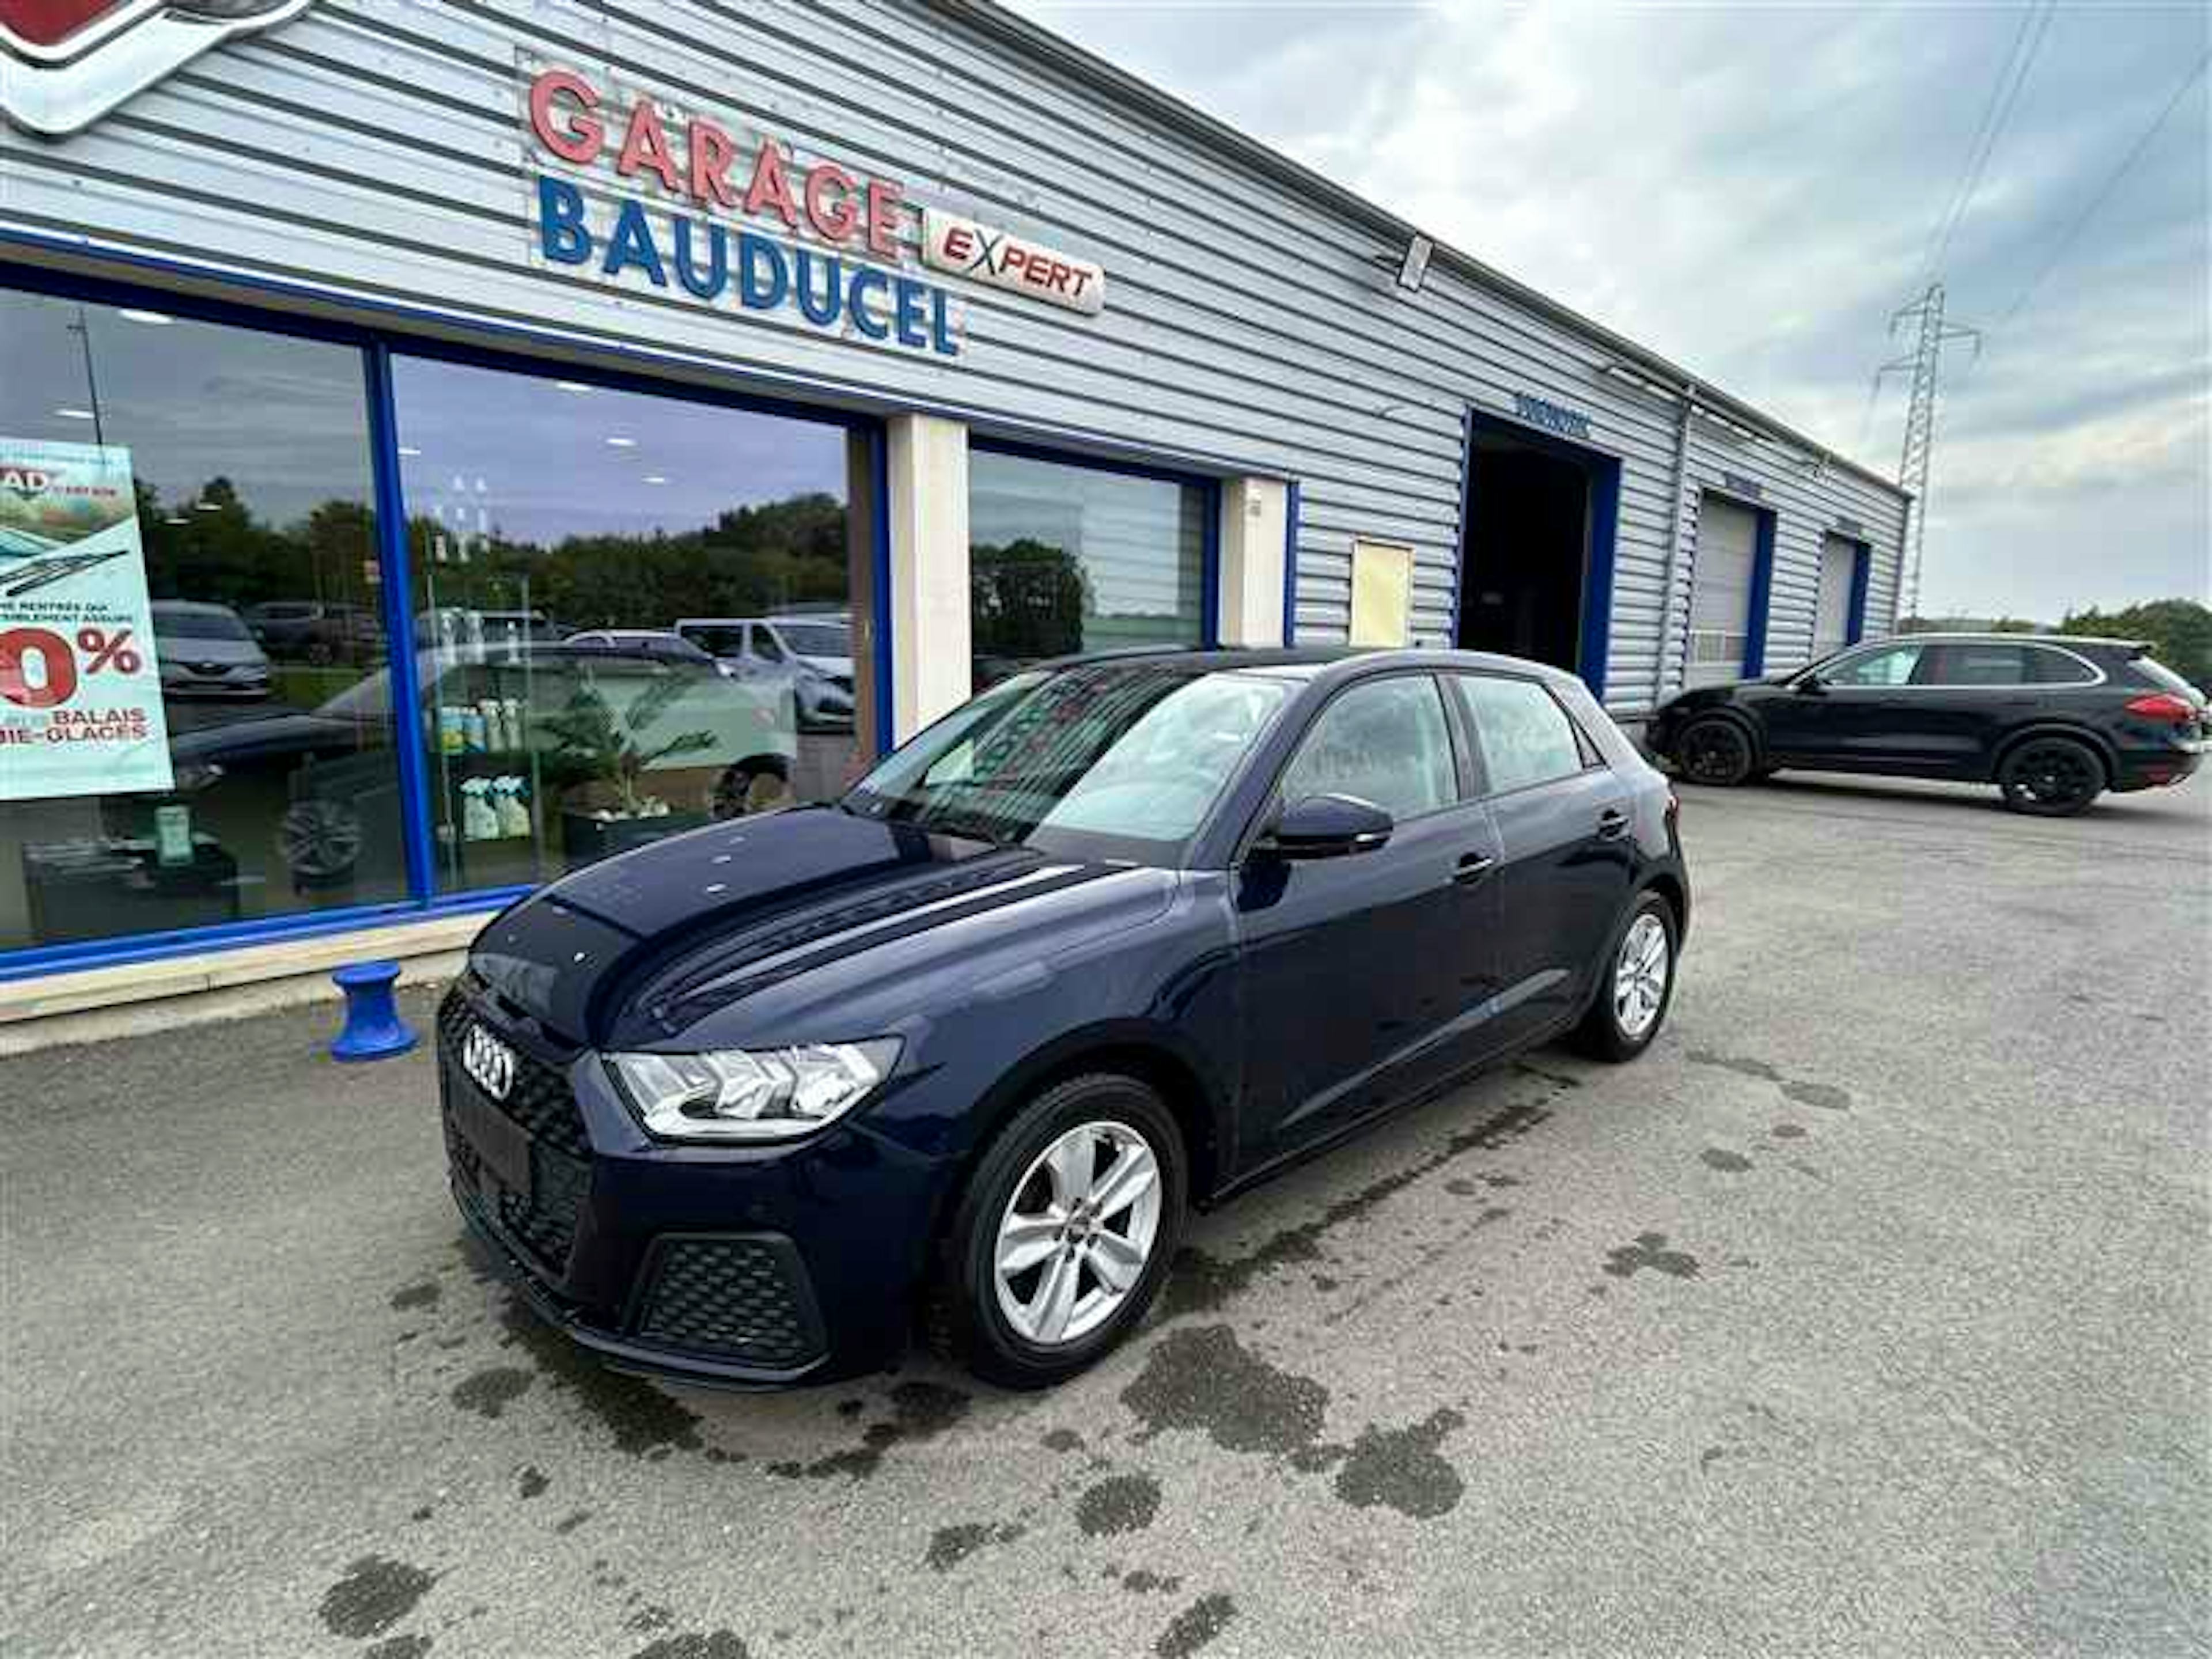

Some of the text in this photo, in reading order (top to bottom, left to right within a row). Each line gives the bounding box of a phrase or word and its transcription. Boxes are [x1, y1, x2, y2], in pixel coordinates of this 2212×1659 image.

[528, 69, 903, 260] GARAGE
[536, 173, 960, 356] BAUDUCEL
[943, 228, 1092, 296] EXPERT
[3, 470, 48, 490] AD
[53, 709, 146, 724] BALAIS
